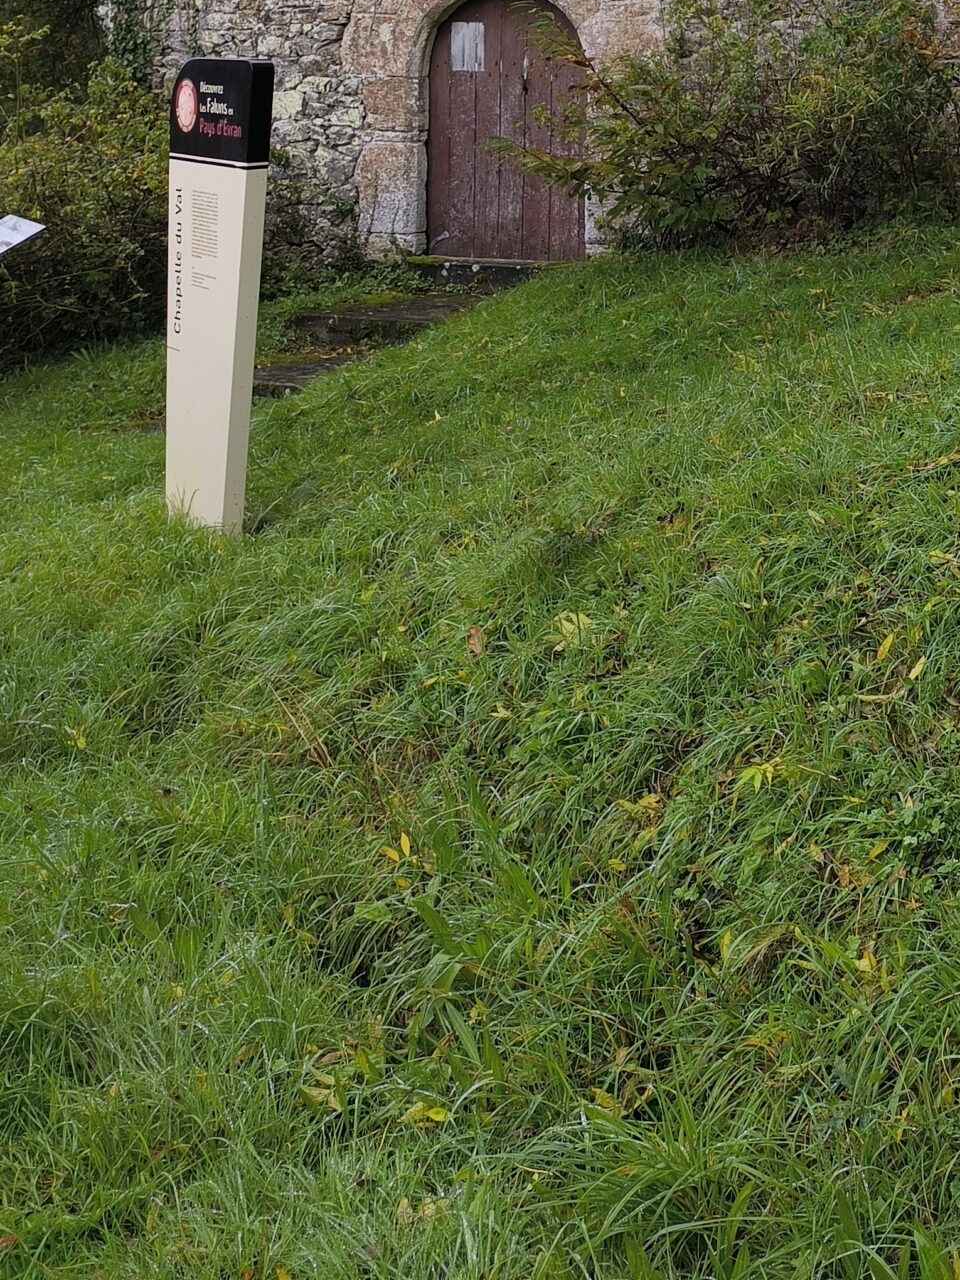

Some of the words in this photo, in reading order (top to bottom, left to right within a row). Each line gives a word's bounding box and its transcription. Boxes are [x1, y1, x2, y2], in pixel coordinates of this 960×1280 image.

[200, 81, 224, 94] Découvrez
[207, 98, 228, 115] Faluns
[199, 118, 215, 137] Pays
[216, 118, 242, 138] d'Évran
[175, 222, 182, 245] du
[173, 251, 182, 334] Chapelle
